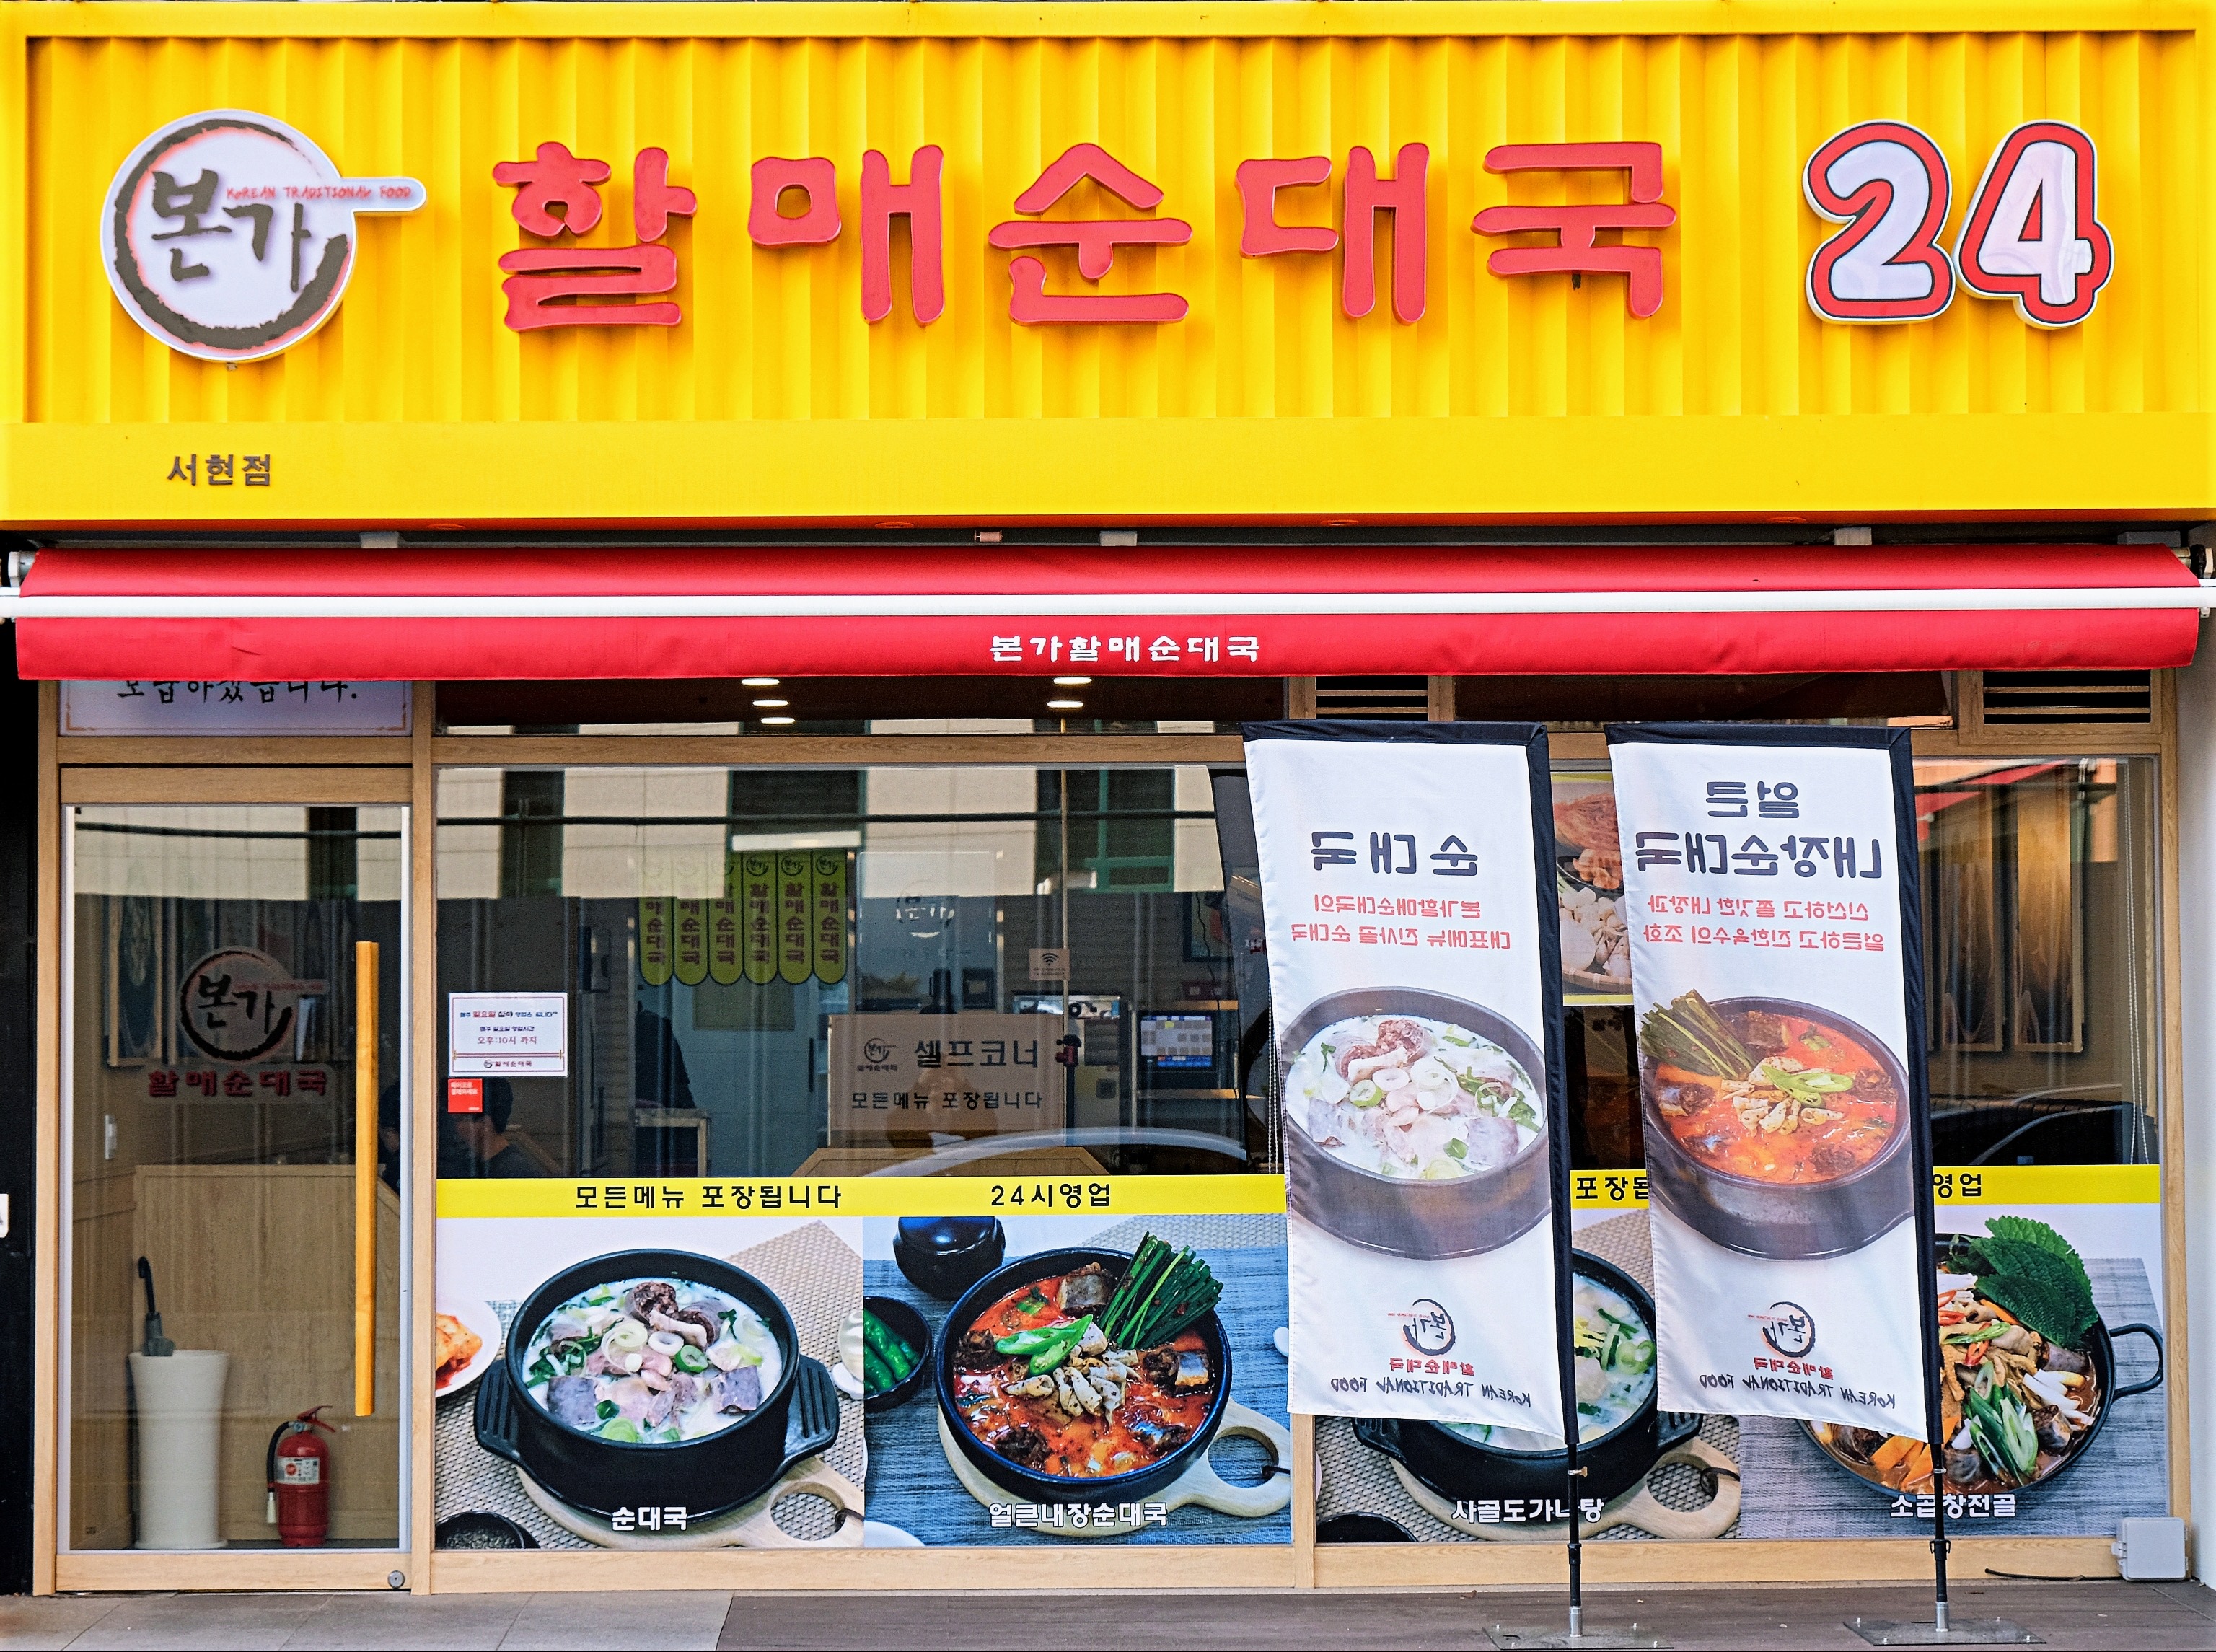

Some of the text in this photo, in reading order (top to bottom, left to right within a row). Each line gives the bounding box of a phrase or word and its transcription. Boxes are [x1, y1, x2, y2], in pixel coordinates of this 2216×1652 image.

[283, 185, 372, 200] TRADITIONAL
[379, 185, 412, 199] FOOD
[151, 168, 311, 292] 본가
[493, 119, 2115, 333] 할매순대국 24
[167, 454, 272, 486] 서현점
[990, 636, 1259, 662] 본가할매순대국
[197, 975, 275, 1034] 본가
[915, 1040, 1037, 1068] 셀프코너
[149, 1070, 326, 1097] 할매순대국
[853, 1091, 1042, 1110] 모든메뉴 포장됩니다
[575, 1185, 842, 1210] 모든메뉴 포장됩니다
[990, 1182, 1112, 1207] 24시영업
[612, 1506, 687, 1532] 순대국
[988, 1502, 1169, 1529] 얼큰내장순대국
[1890, 1493, 2016, 1519] 소곱창전골
